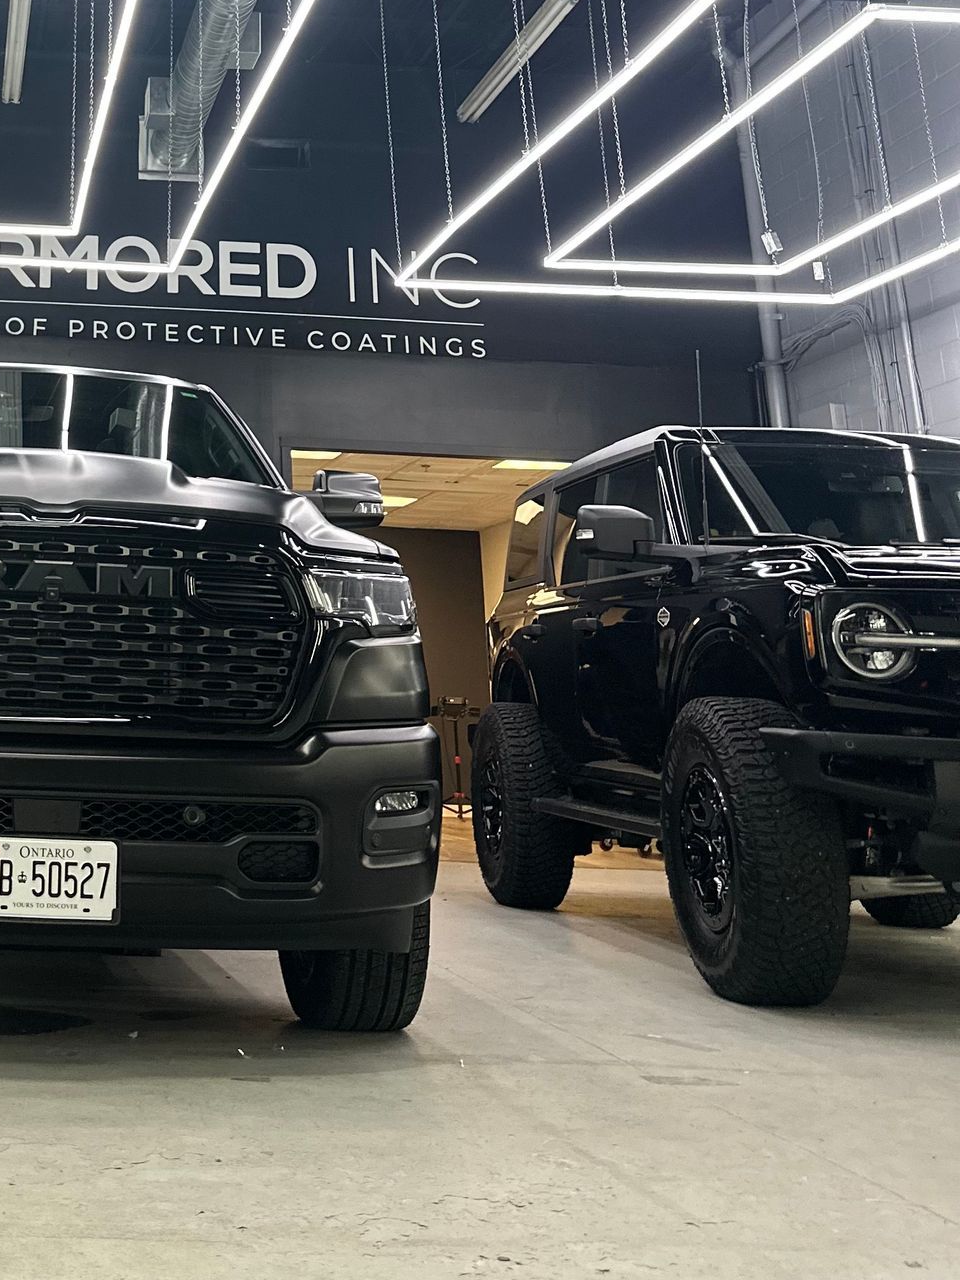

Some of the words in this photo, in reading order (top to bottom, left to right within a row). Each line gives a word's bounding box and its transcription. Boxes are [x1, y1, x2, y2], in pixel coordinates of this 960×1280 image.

[347, 247, 481, 308] INC
[5, 317, 47, 336] OF
[68, 319, 286, 347] PROTECTIVE
[307, 330, 487, 358] COATINGS
[31, 860, 111, 899] 50527
[46, 902, 78, 910] DISCOVER
